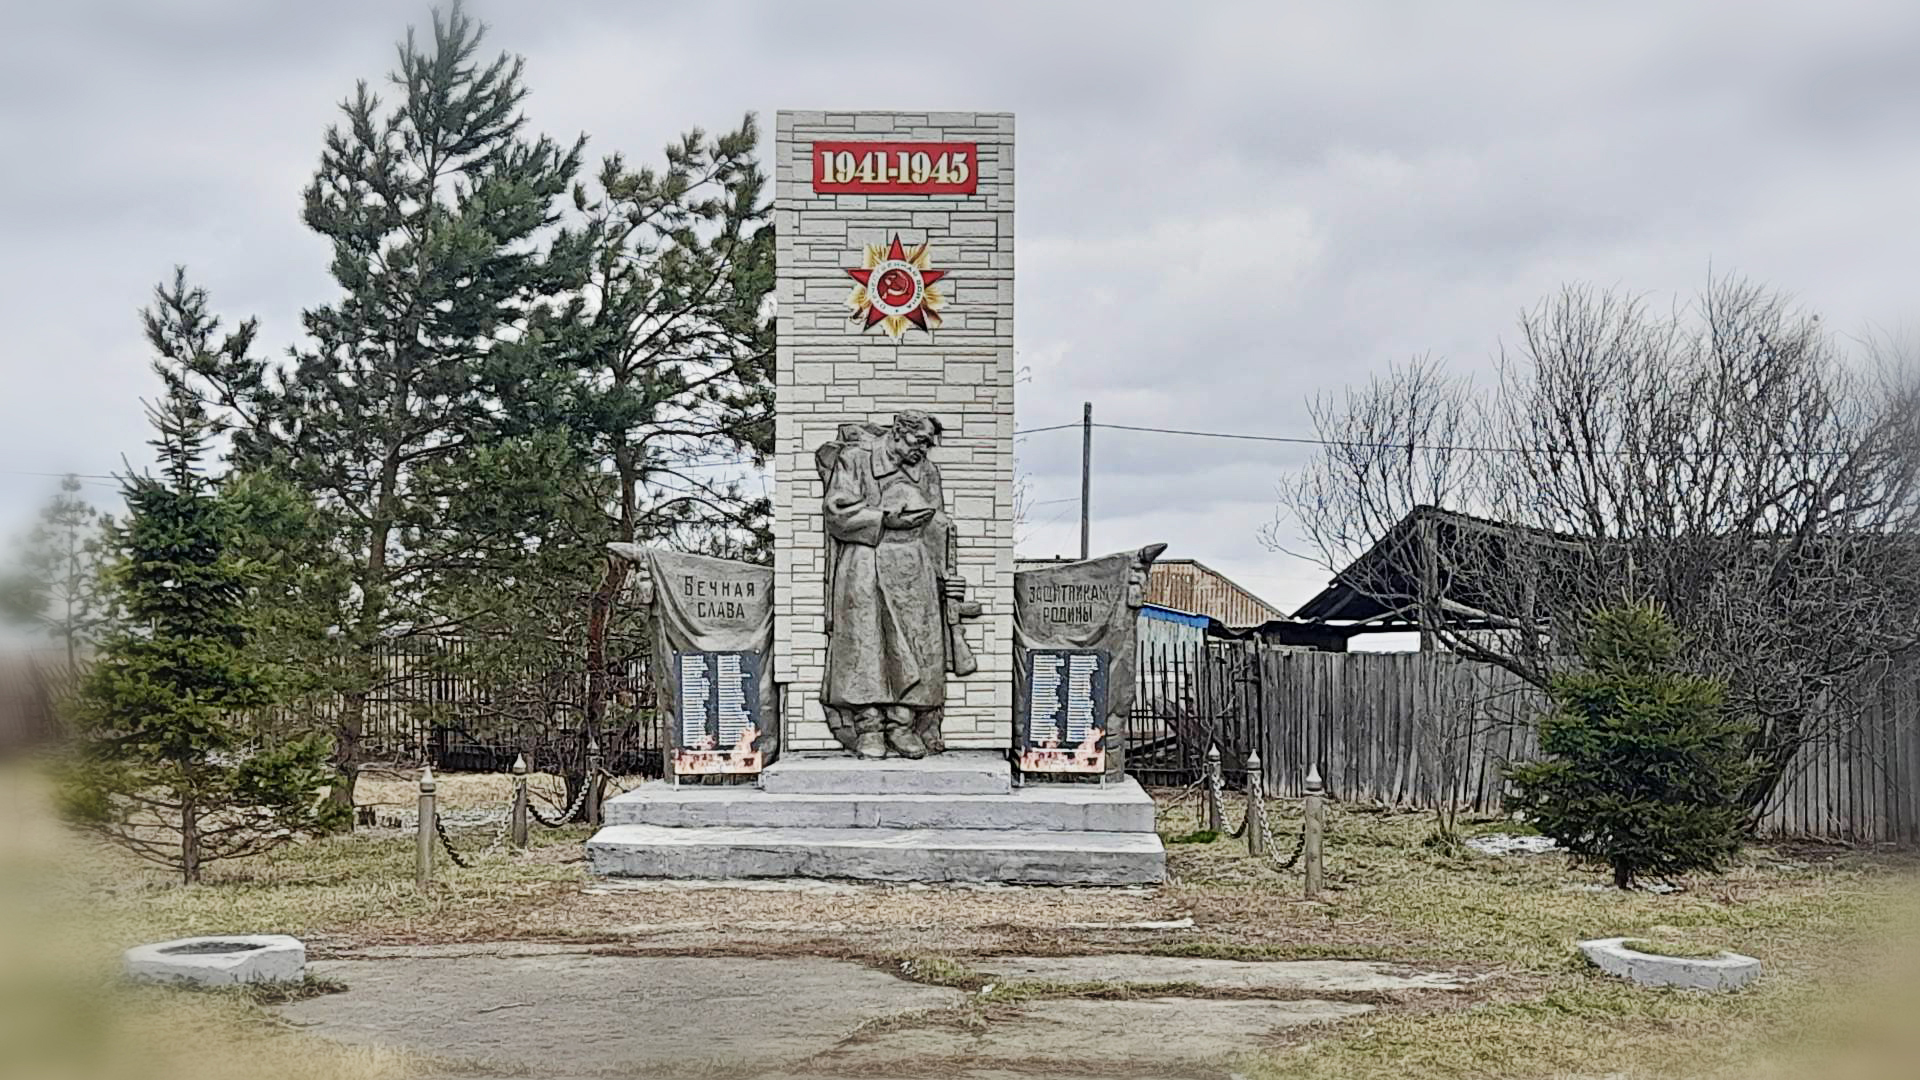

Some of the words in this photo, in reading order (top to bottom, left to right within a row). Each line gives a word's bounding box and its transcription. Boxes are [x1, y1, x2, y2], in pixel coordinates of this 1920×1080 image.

[821, 151, 969, 184] 1941-1945
[684, 575, 755, 597] ВЕЧНАЯ
[697, 601, 745, 619] СЛАВА
[1043, 605, 1093, 623] РОДИНЫ
